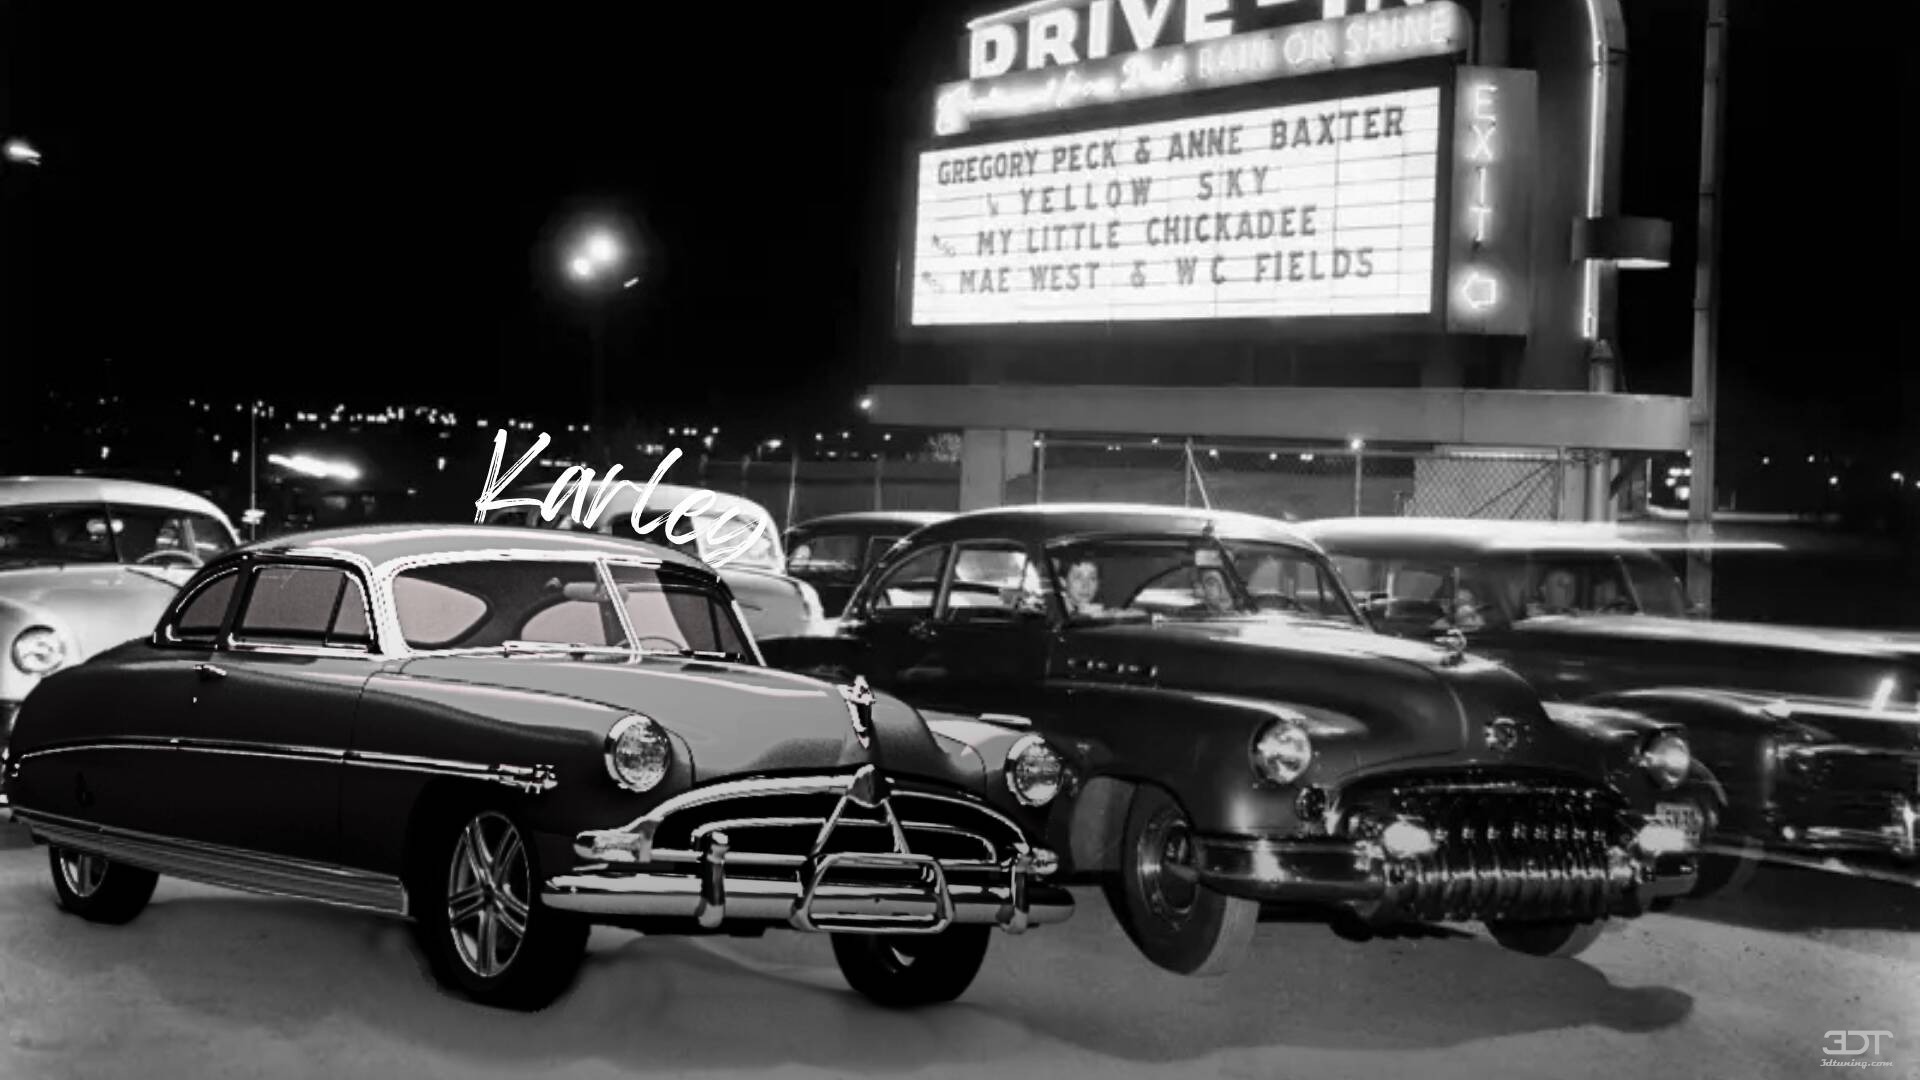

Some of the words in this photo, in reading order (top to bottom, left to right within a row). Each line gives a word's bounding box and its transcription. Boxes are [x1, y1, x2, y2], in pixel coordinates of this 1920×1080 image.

[969, 0, 1426, 79] DRIVE-
[1198, 39, 1277, 79] RAIN
[1283, 28, 1333, 65] OR
[1344, 7, 1450, 57] SHINE
[937, 149, 1039, 186] GREGORY
[1052, 140, 1118, 174] PECK
[1135, 135, 1151, 165] &
[1168, 125, 1244, 162] ANNE
[1270, 106, 1406, 151] BAXTER
[1466, 83, 1499, 242] EXIT
[1019, 177, 1153, 216] YELLOW
[1197, 166, 1269, 201] SKY
[977, 228, 1013, 257] MY
[1027, 220, 1120, 254] LITTLE
[1146, 204, 1317, 247] CHICKADEE
[959, 266, 1011, 294] MAE
[1029, 261, 1100, 291] WEST
[1130, 259, 1147, 288] &
[1254, 247, 1374, 283] FIELDS
